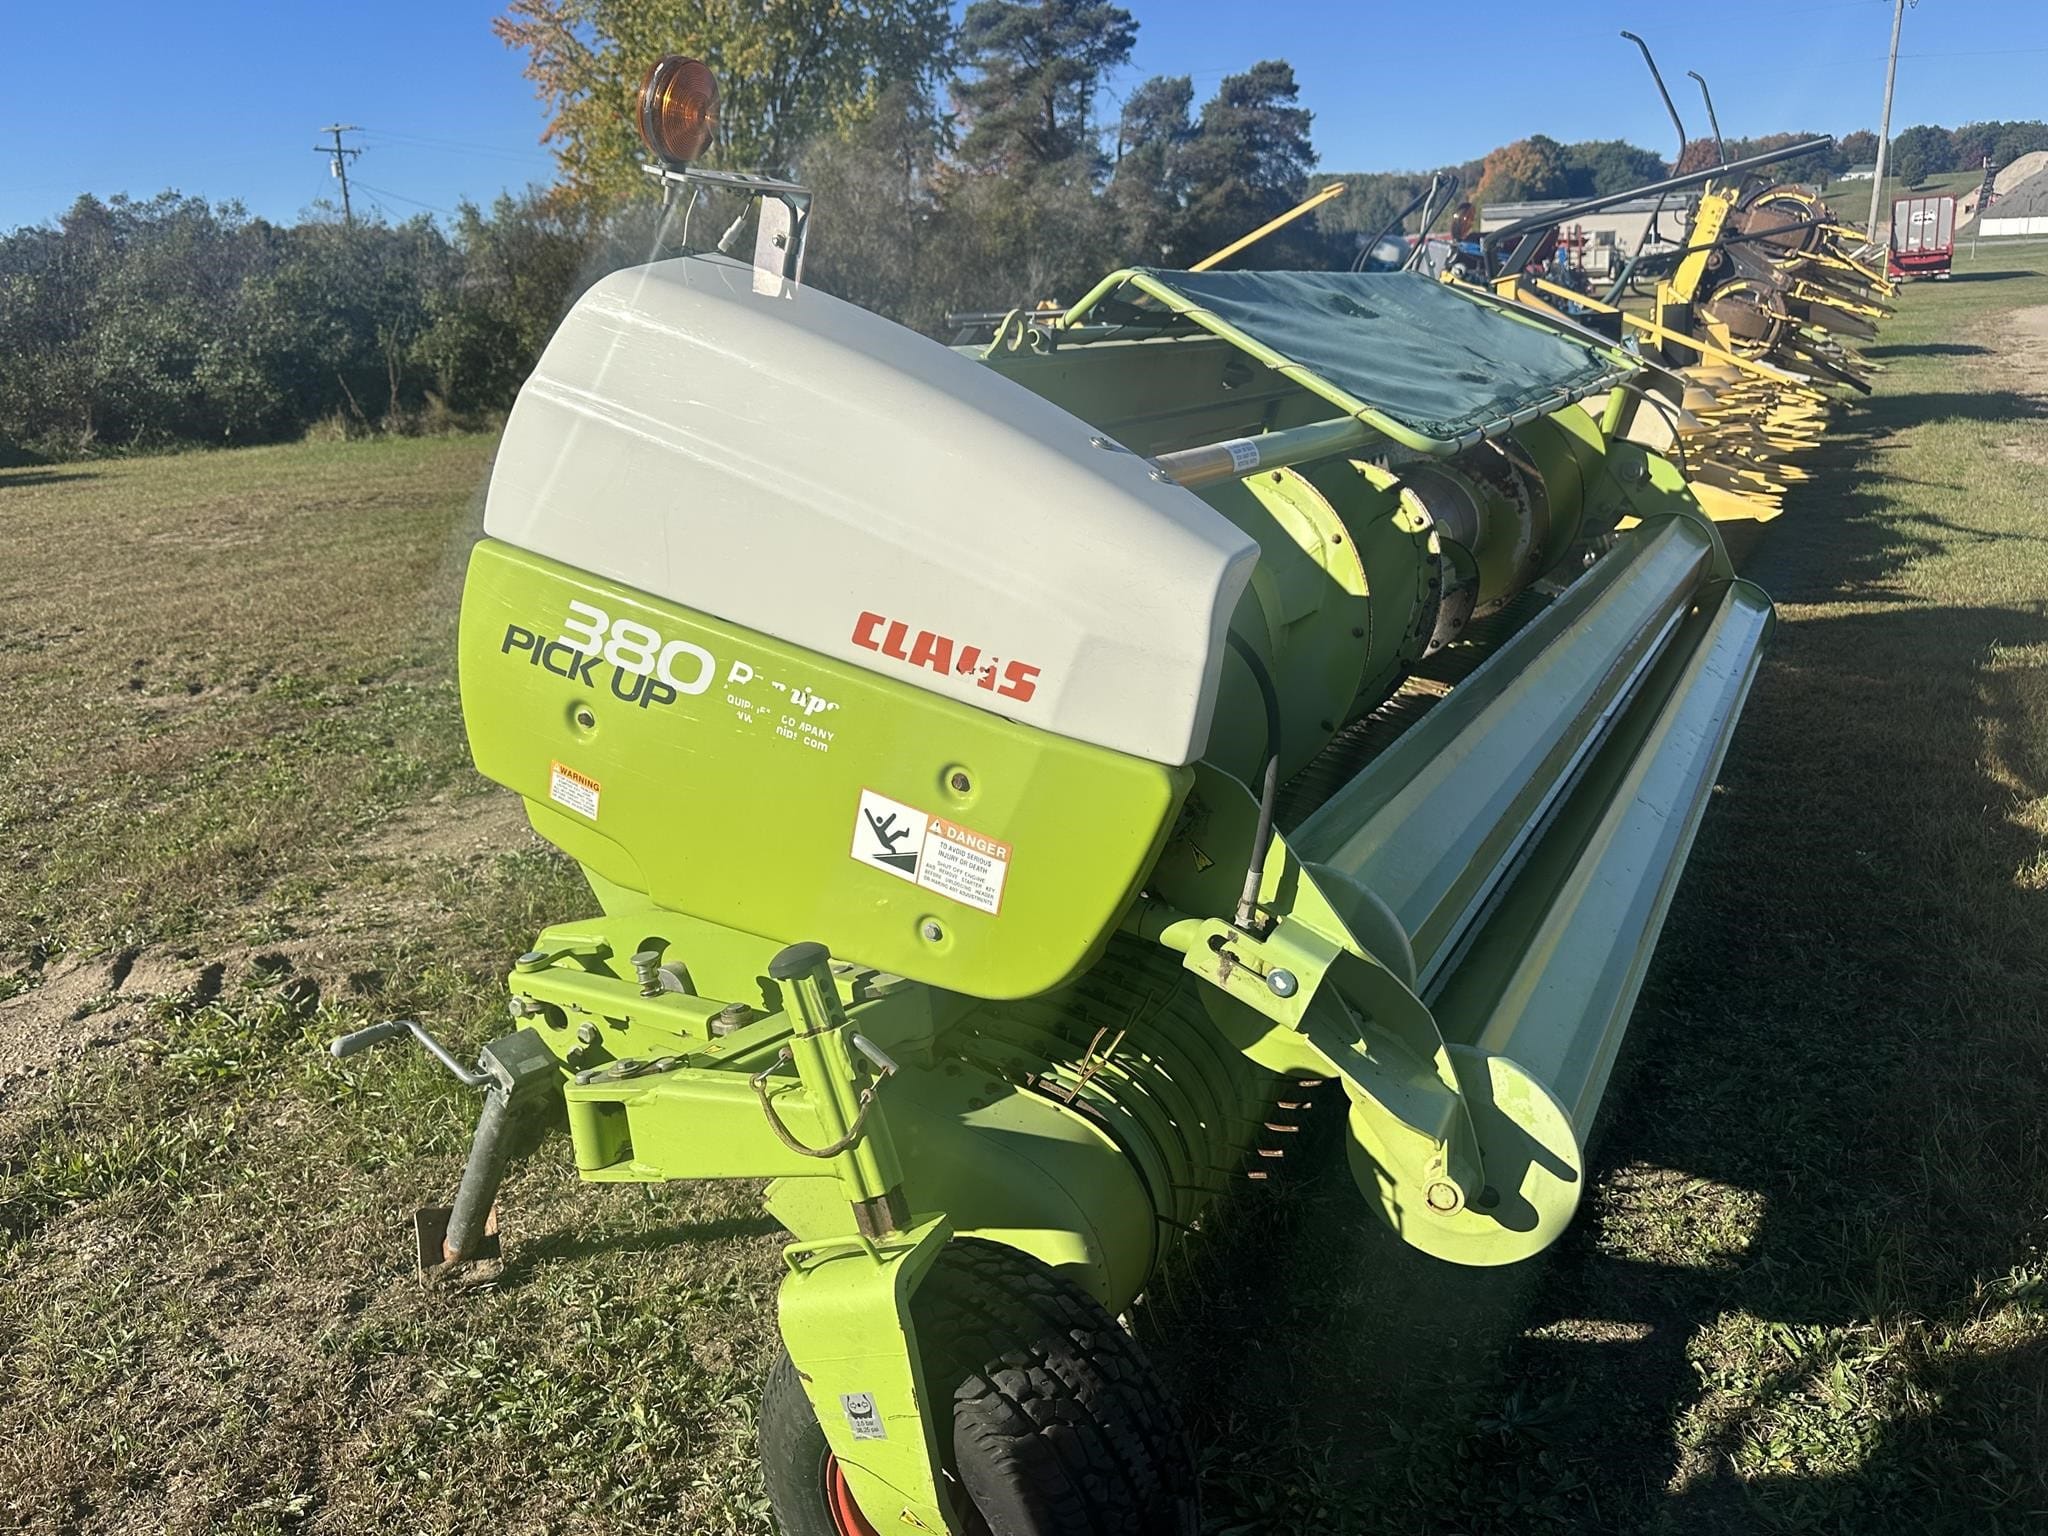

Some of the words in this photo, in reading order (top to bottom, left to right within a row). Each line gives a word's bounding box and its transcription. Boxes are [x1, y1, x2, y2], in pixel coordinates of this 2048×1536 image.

[557, 599, 716, 695] 380
[501, 624, 603, 688] PICK
[611, 666, 677, 709] UP
[560, 766, 600, 792] WARNING
[940, 841, 947, 850] TO
[948, 845, 966, 857] AVOID
[967, 853, 992, 867] SERIOUS
[947, 828, 1006, 858] DANGER
[938, 850, 958, 864] INJURY
[960, 858, 968, 867] OR
[969, 862, 987, 874] DEATH
